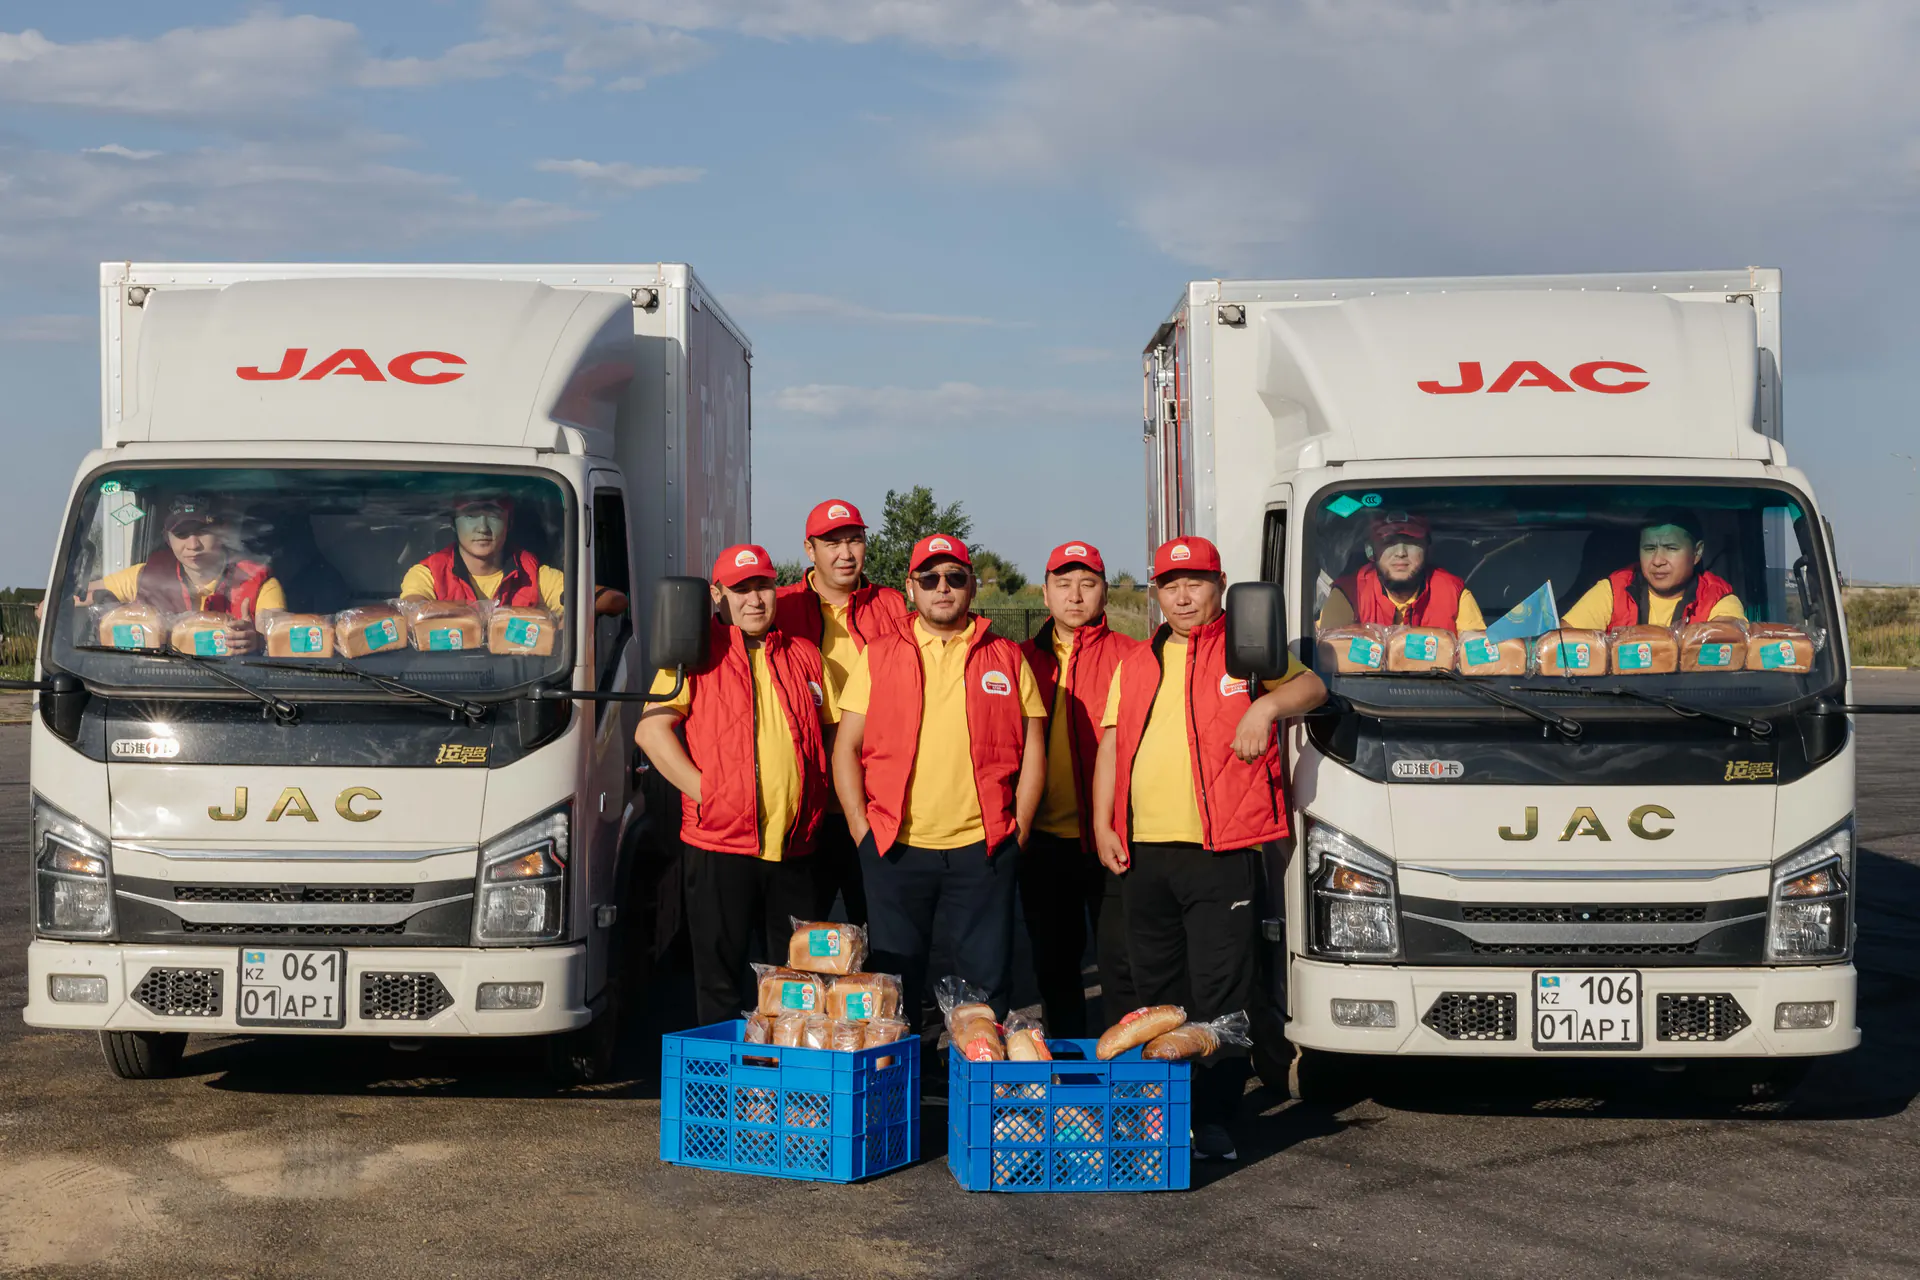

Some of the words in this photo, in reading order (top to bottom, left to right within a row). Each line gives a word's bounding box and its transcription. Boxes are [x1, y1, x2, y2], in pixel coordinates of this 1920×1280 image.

[236, 348, 466, 385] JAC
[1417, 360, 1650, 394] JAC
[208, 786, 383, 823] JAC
[1498, 804, 1675, 842] JAC
[245, 968, 264, 980] KZ
[282, 952, 336, 982] 061
[244, 989, 276, 1016] 01
[283, 995, 333, 1018] API
[1540, 992, 1559, 1005] KZ
[1579, 976, 1633, 1005] 106
[1540, 1014, 1573, 1040] 01
[1580, 1019, 1630, 1041] API
